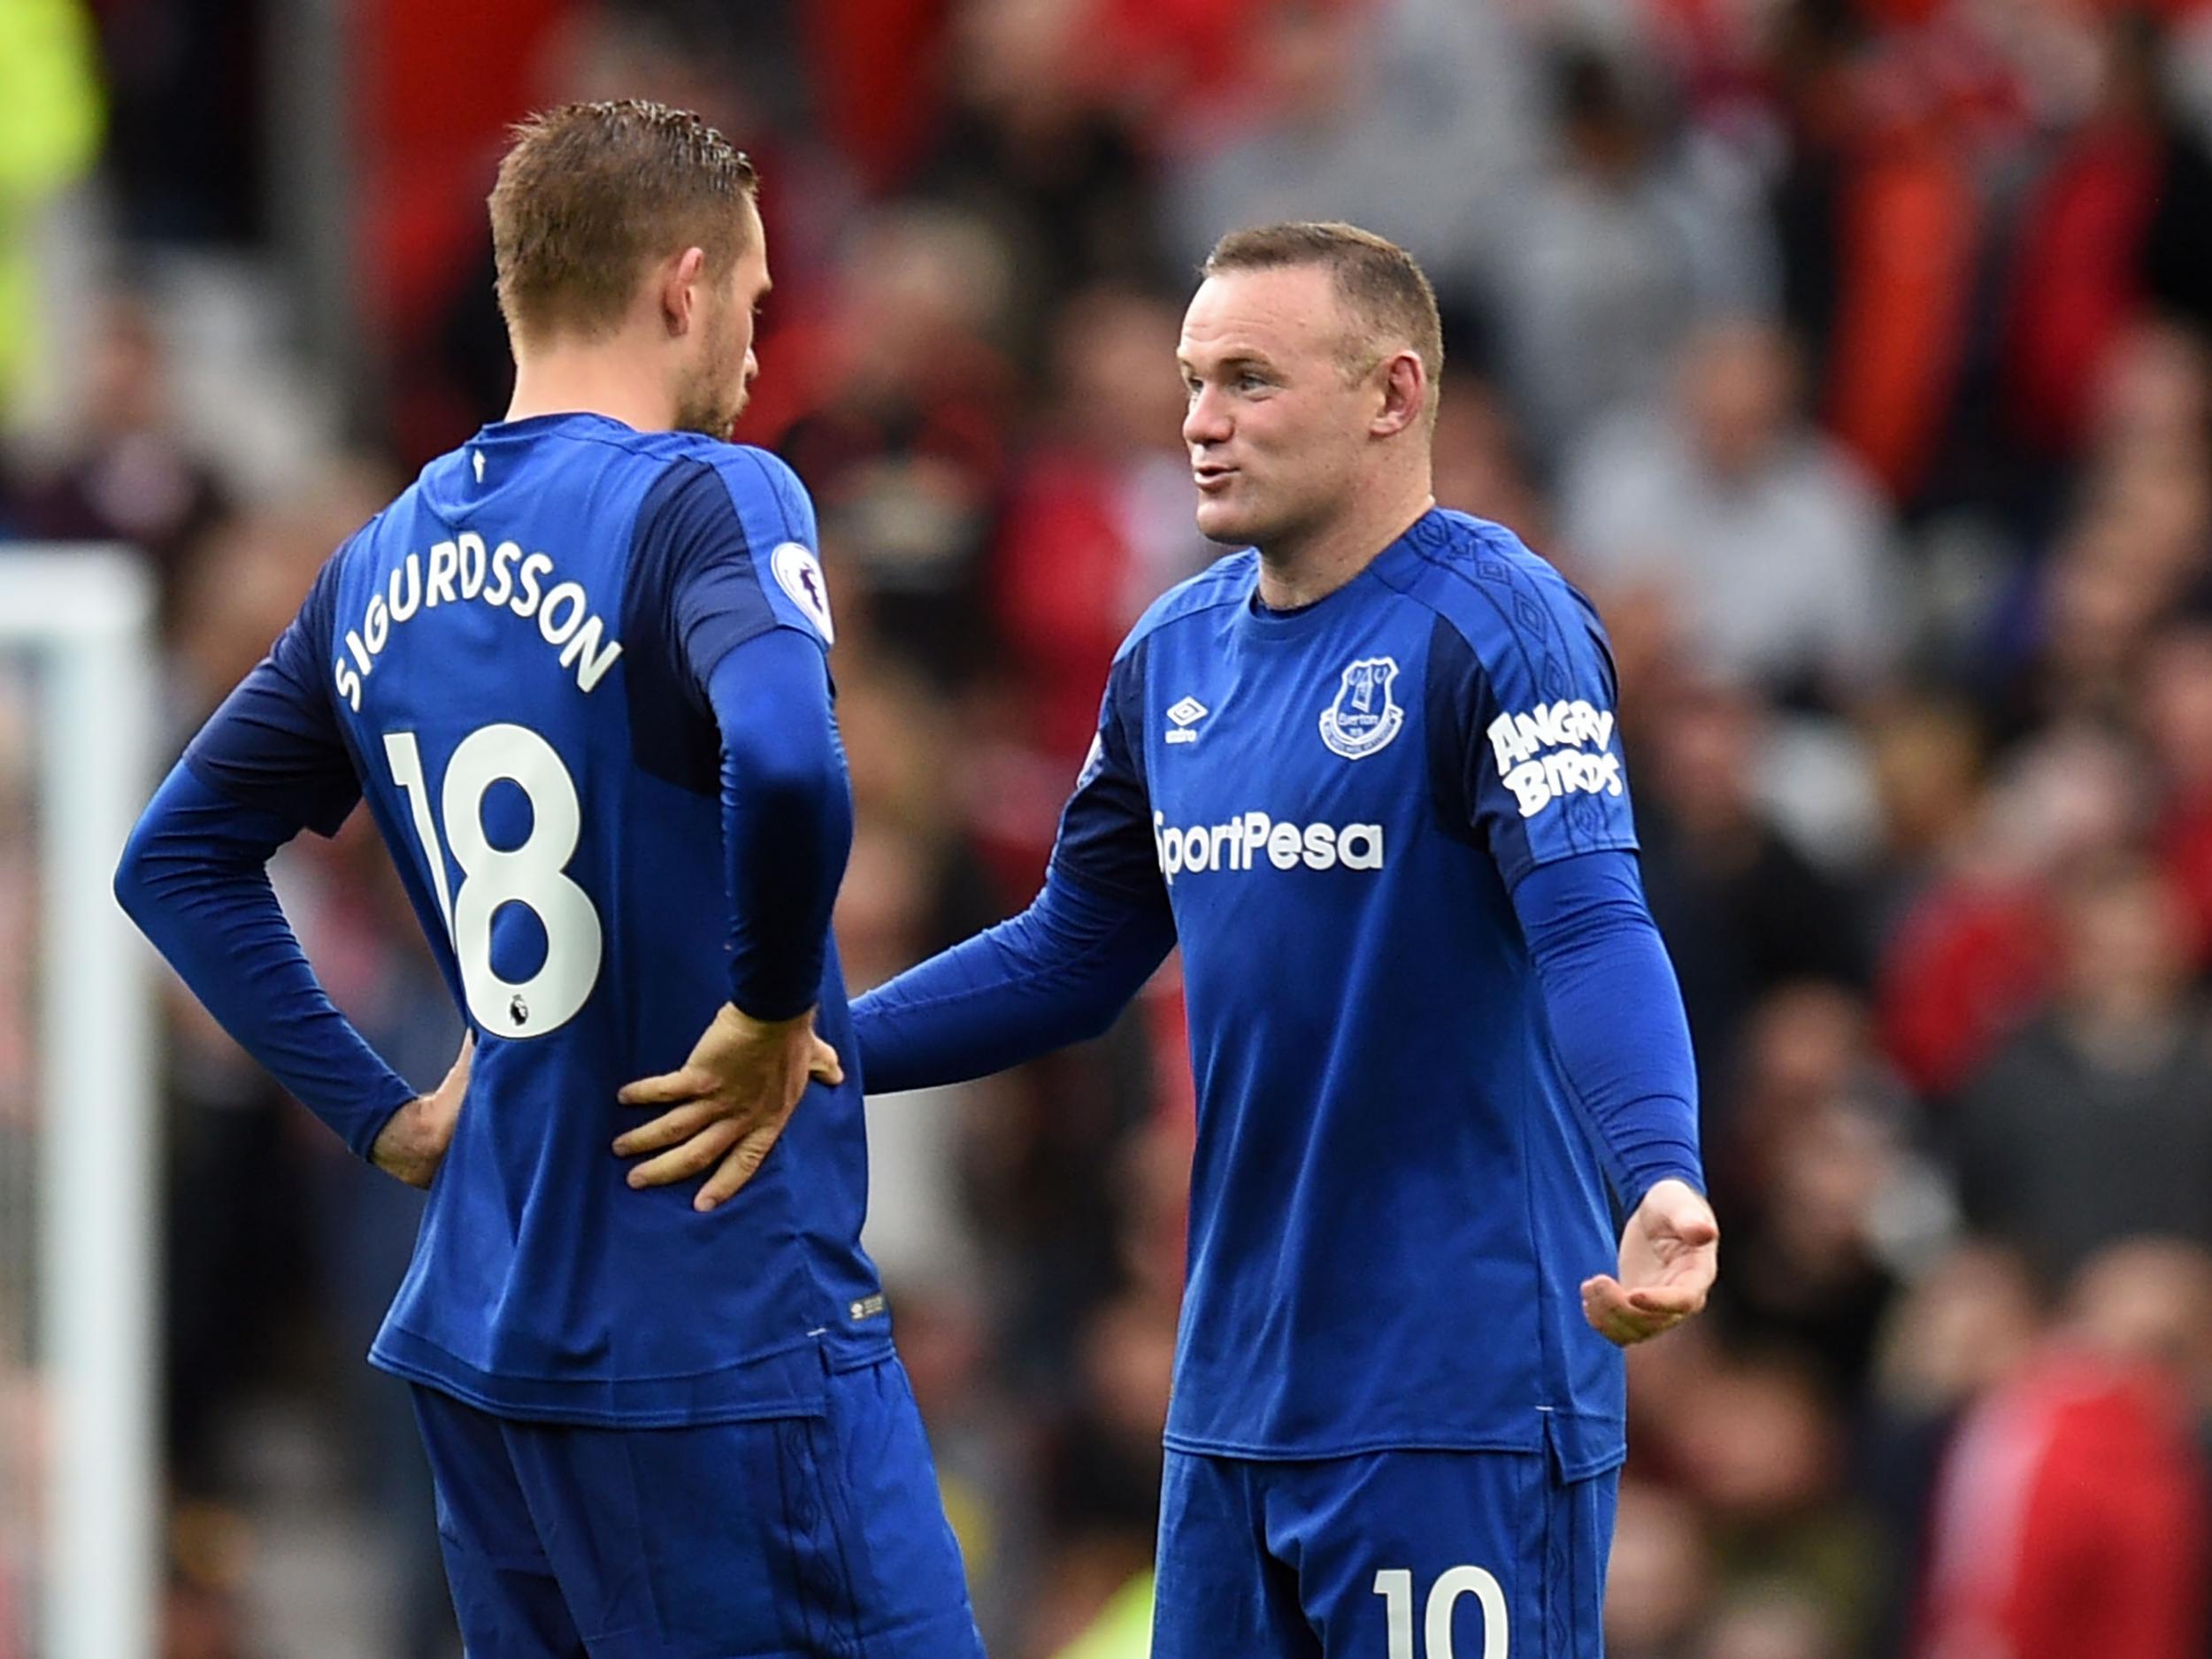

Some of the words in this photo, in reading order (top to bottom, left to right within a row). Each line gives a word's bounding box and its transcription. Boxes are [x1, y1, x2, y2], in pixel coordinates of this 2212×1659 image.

[335, 531, 623, 711] SIGURDSSON
[1486, 699, 1614, 776] ANGRY
[1502, 749, 1622, 818] BIRDS
[383, 723, 603, 1038] 18
[1373, 1565, 1509, 1659] 10
